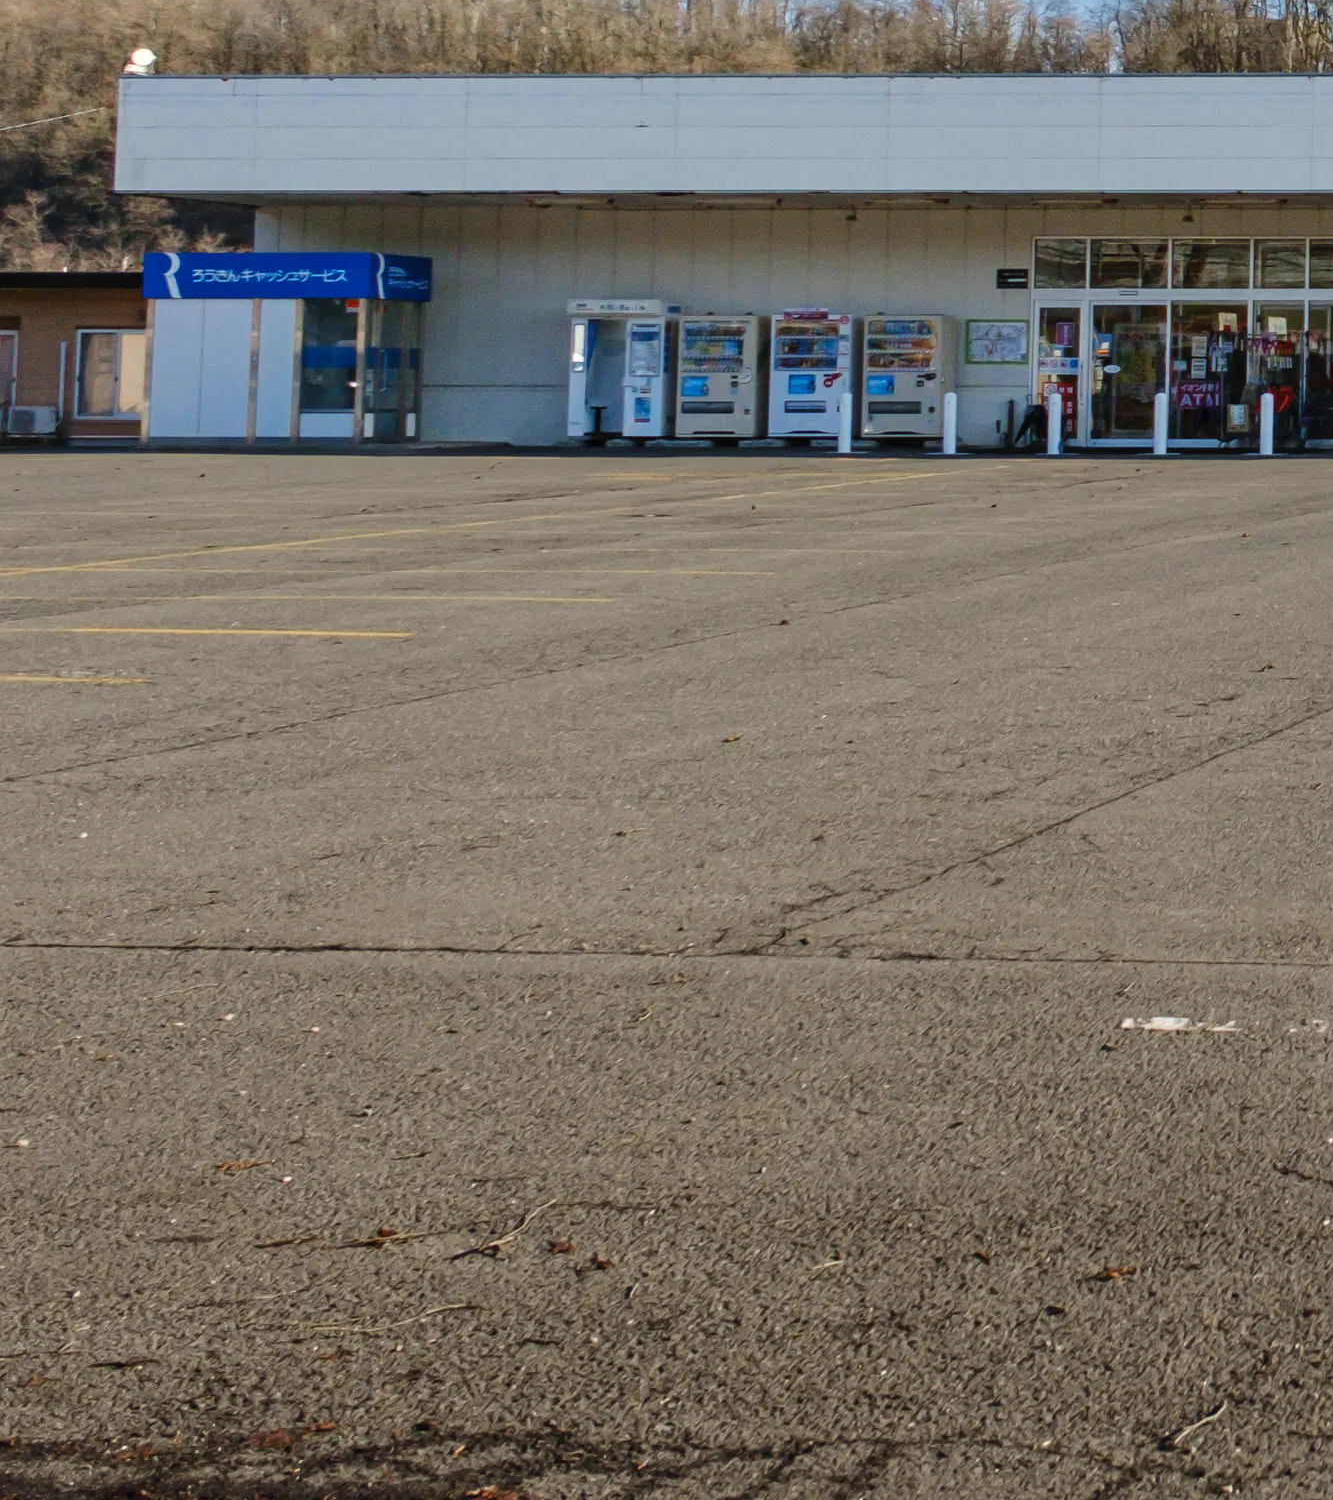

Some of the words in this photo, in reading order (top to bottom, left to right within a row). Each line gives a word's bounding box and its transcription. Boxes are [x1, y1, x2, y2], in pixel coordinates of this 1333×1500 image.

[192, 269, 348, 283] ろうきんキャッシュサービス
